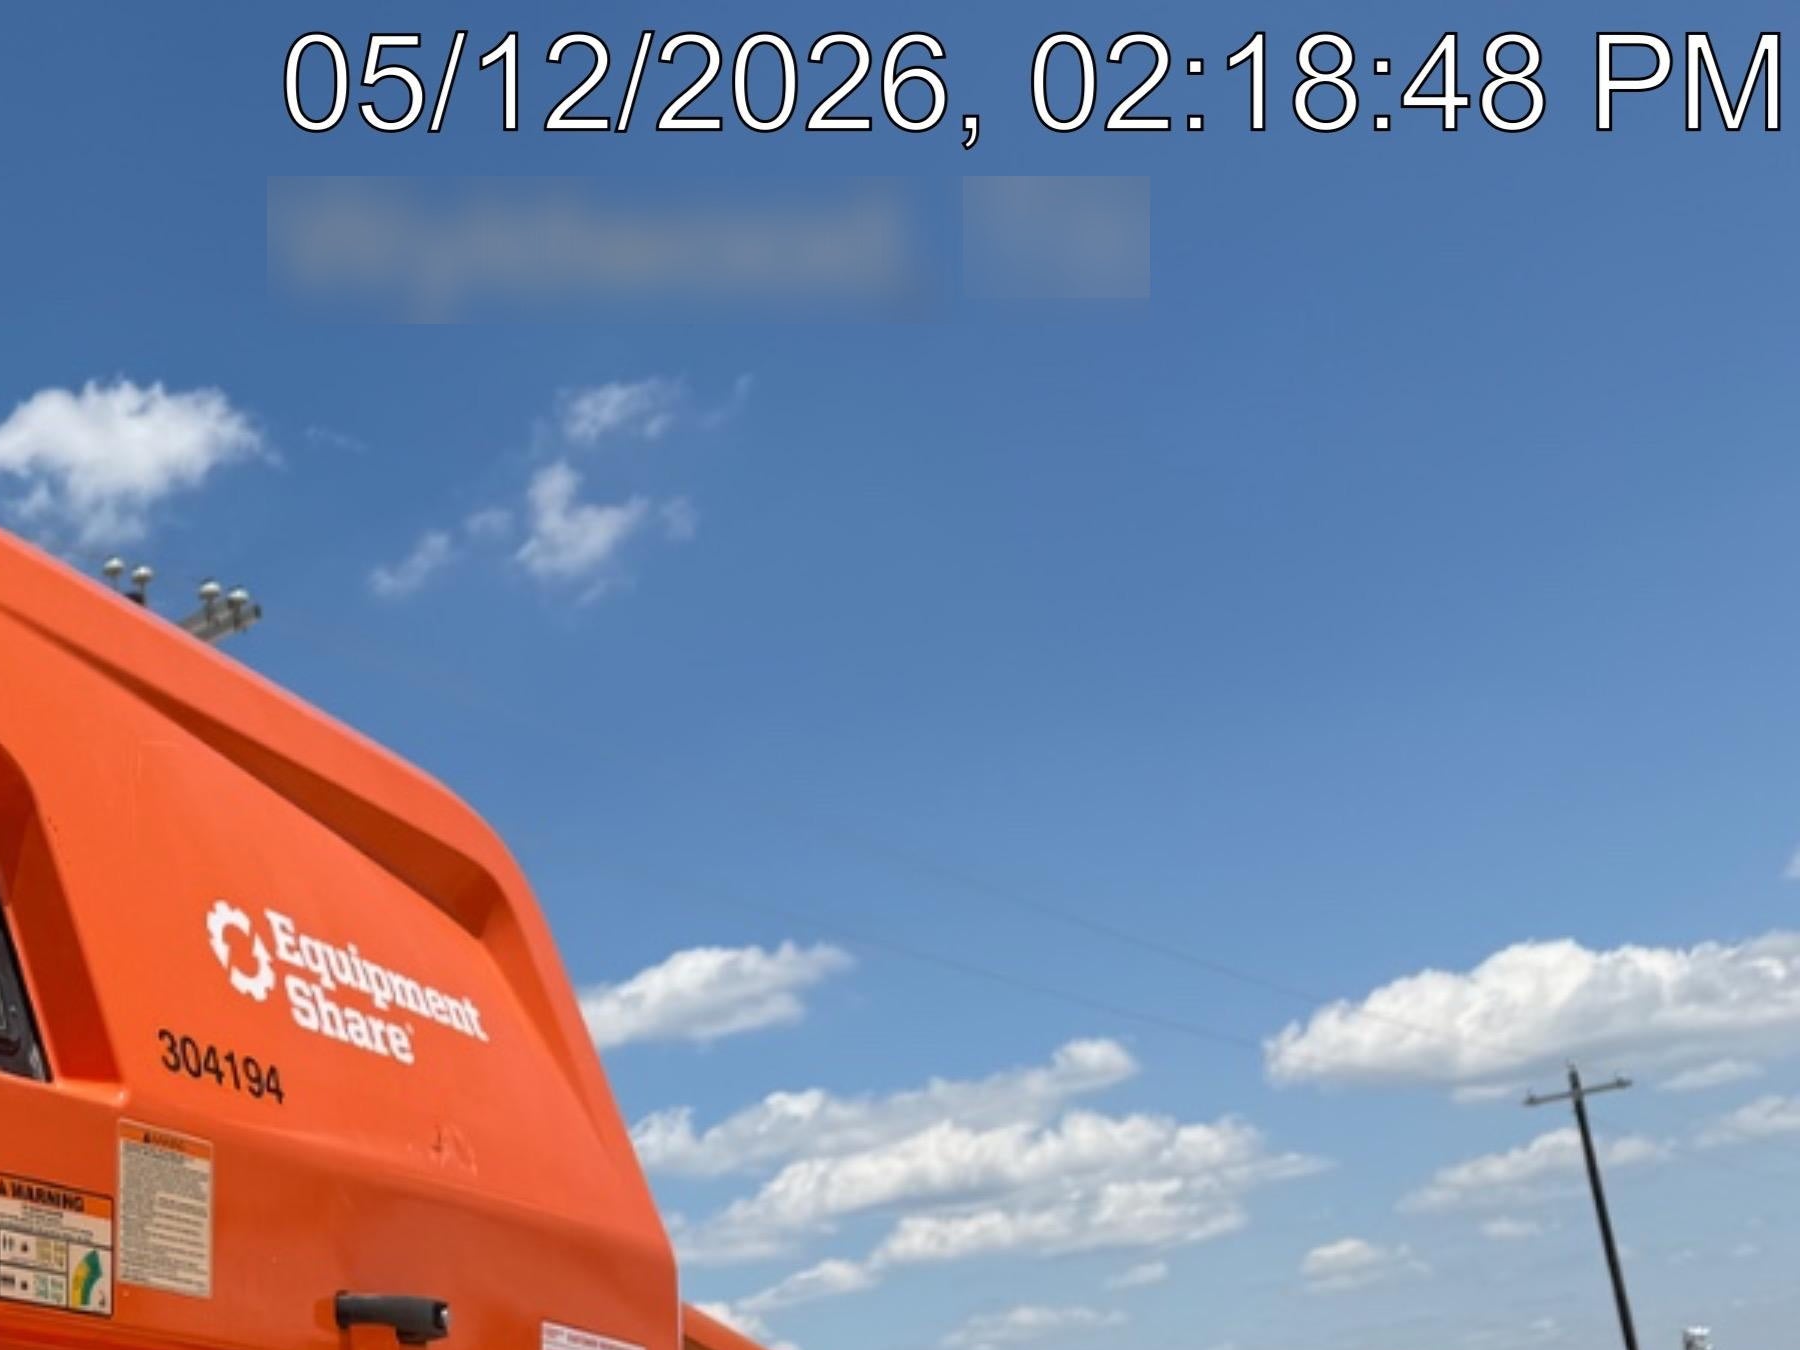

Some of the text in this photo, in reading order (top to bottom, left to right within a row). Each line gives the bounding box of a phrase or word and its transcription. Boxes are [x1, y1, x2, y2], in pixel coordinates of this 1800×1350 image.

[264, 907, 490, 1043] Equipment
[284, 973, 414, 1066] Share
[158, 1028, 284, 1104] 304194
[11, 1180, 84, 1212] WARNING
